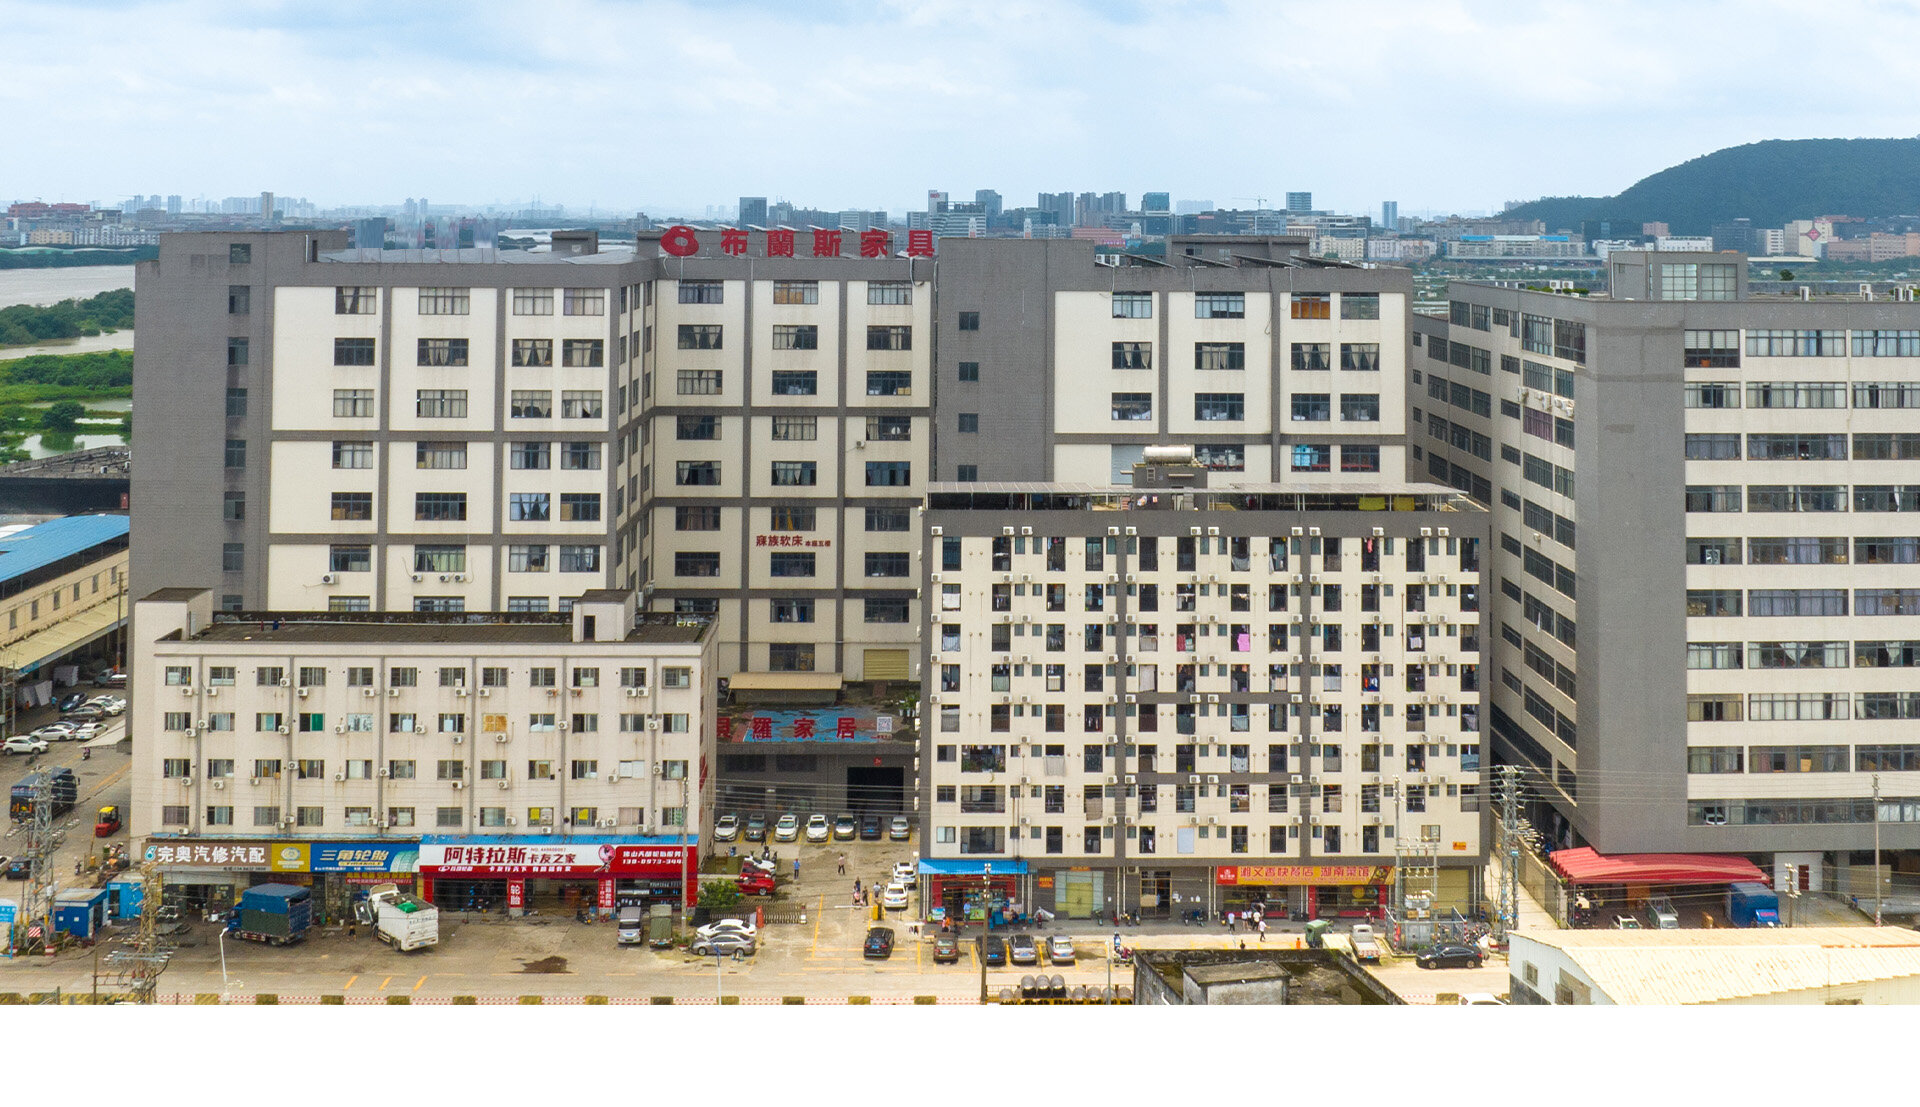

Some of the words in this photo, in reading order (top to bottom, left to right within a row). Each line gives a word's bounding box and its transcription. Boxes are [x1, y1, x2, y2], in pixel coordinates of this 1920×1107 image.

[720, 228, 935, 258] 布蘭斯家具
[157, 845, 265, 863] 完奥汽修汽配
[320, 850, 389, 861] 三角轮胎
[443, 847, 527, 864] 阿特拉斯
[528, 853, 577, 864] 卡友之家
[1320, 866, 1370, 877] 湖南菜馆
[510, 884, 521, 905] 轮胎
